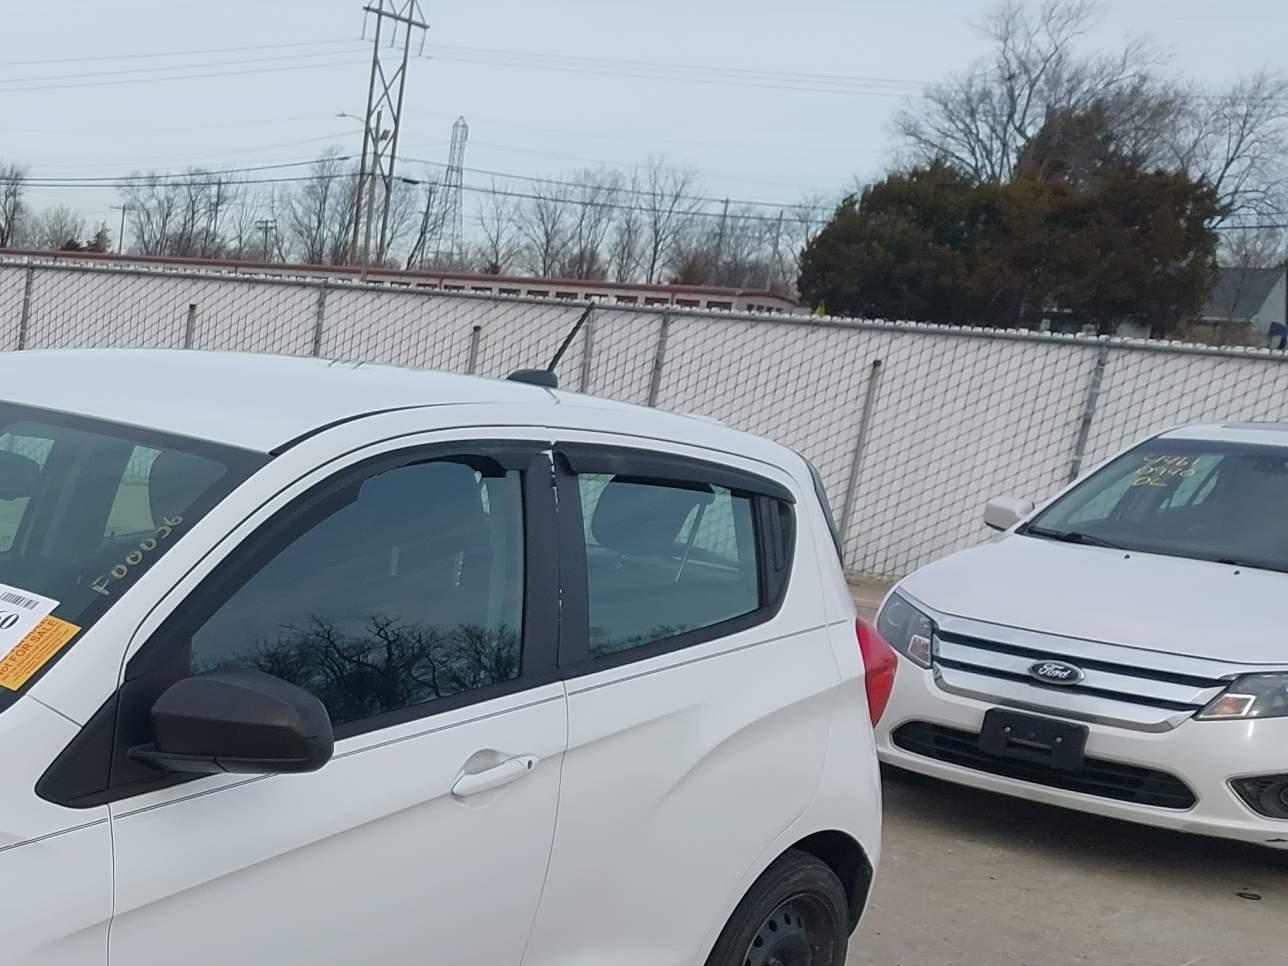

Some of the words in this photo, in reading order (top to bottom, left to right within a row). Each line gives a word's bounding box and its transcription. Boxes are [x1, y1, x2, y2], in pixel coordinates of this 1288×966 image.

[9, 643, 33, 662] FOR
[30, 619, 58, 643] SALE
[1038, 663, 1072, 679] Ford
